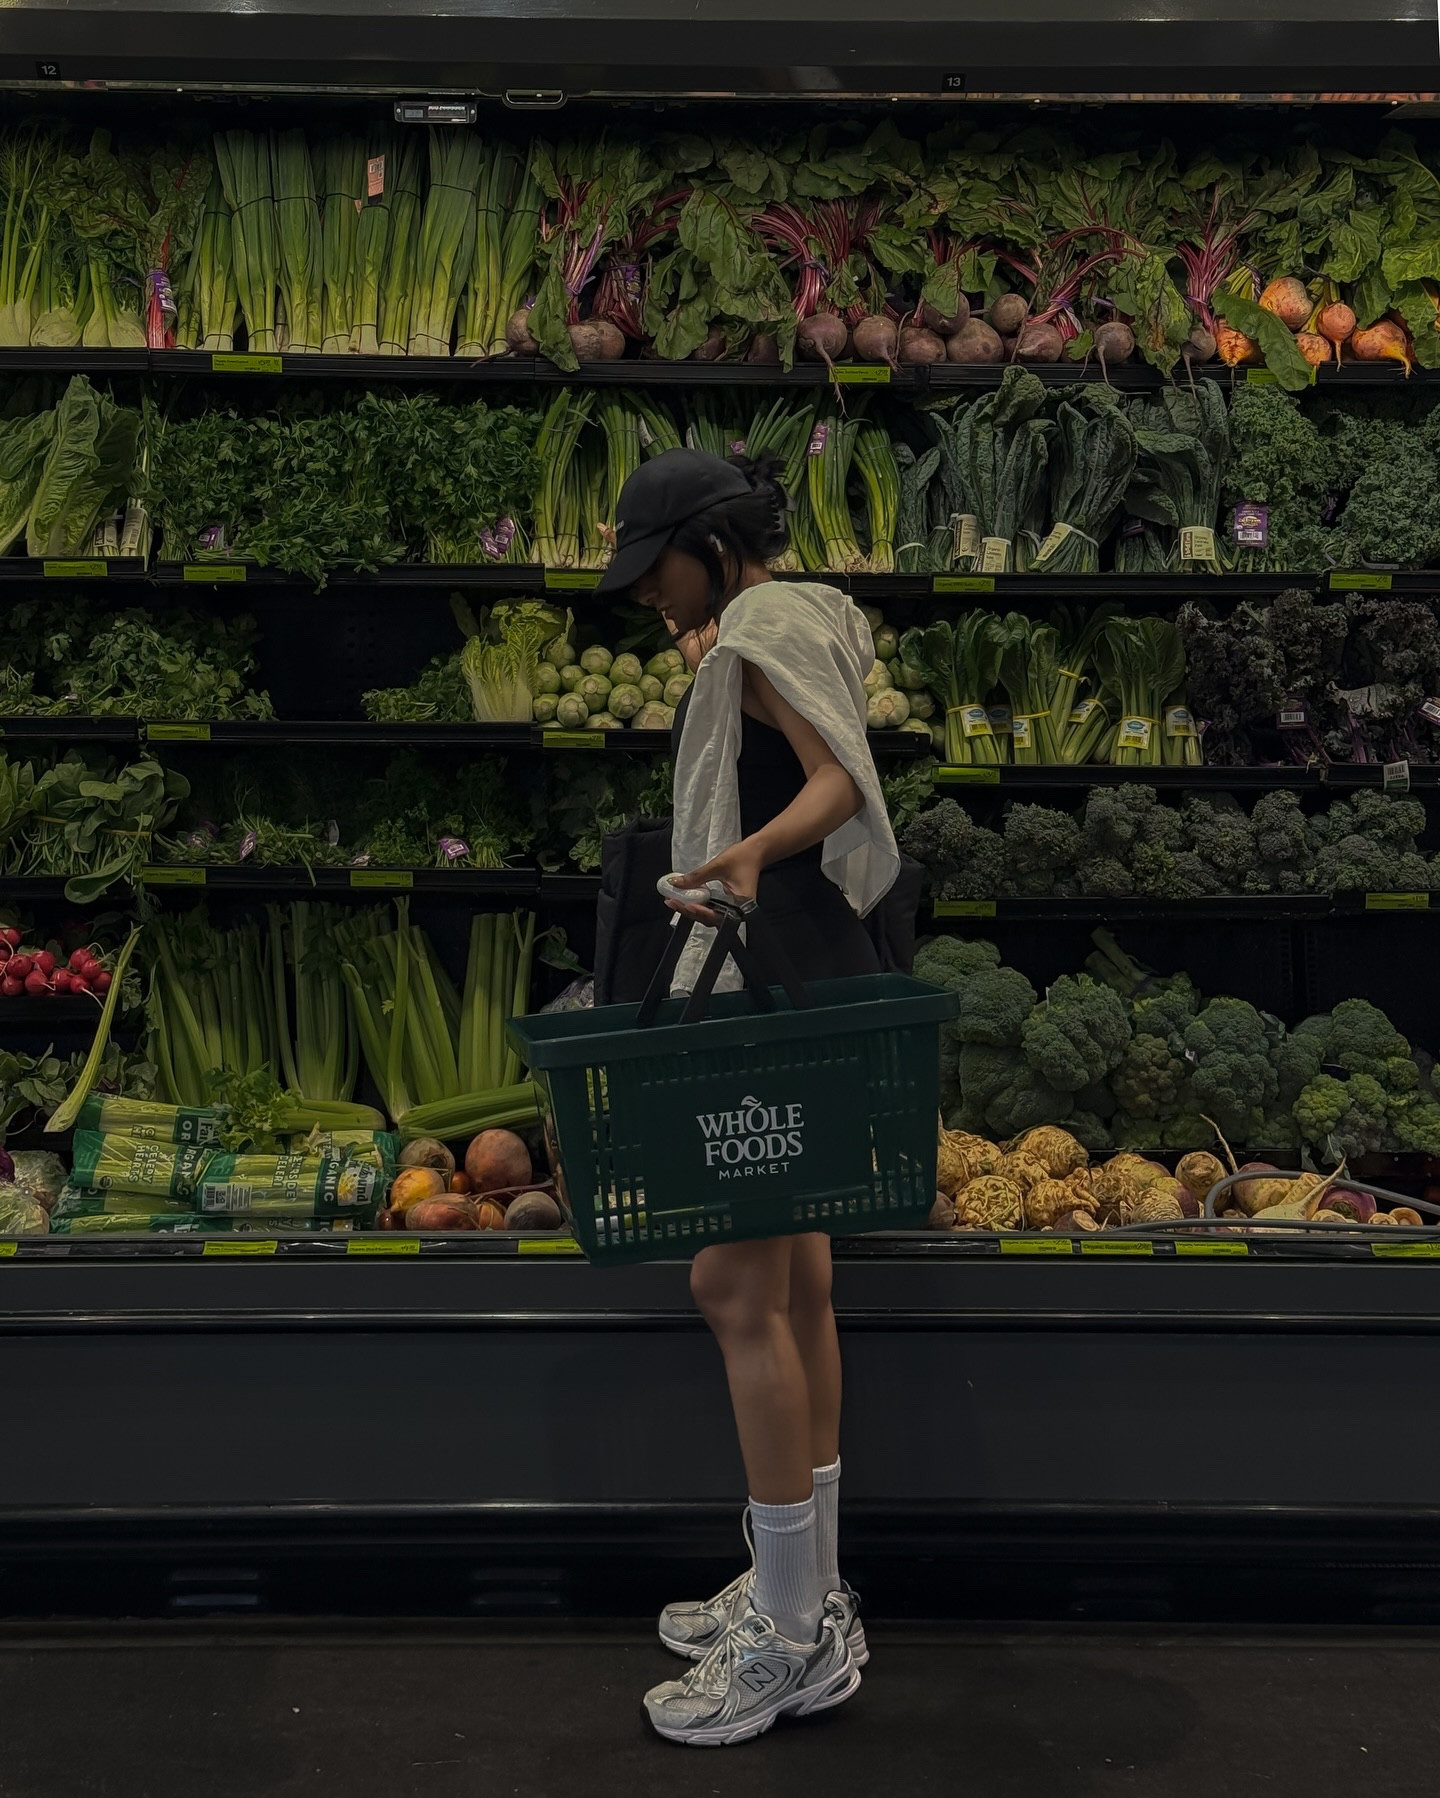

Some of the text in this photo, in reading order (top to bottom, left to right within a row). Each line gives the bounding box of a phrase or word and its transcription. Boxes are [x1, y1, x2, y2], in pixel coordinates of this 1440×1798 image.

[41, 65, 57, 75] 12
[947, 77, 961, 88] 13
[696, 1095, 805, 1139] WHOLE
[128, 1143, 147, 1184] HEARTS
[141, 1144, 160, 1185] CELERY
[704, 1131, 804, 1167] FOODS
[718, 1162, 790, 1181] MARKET
